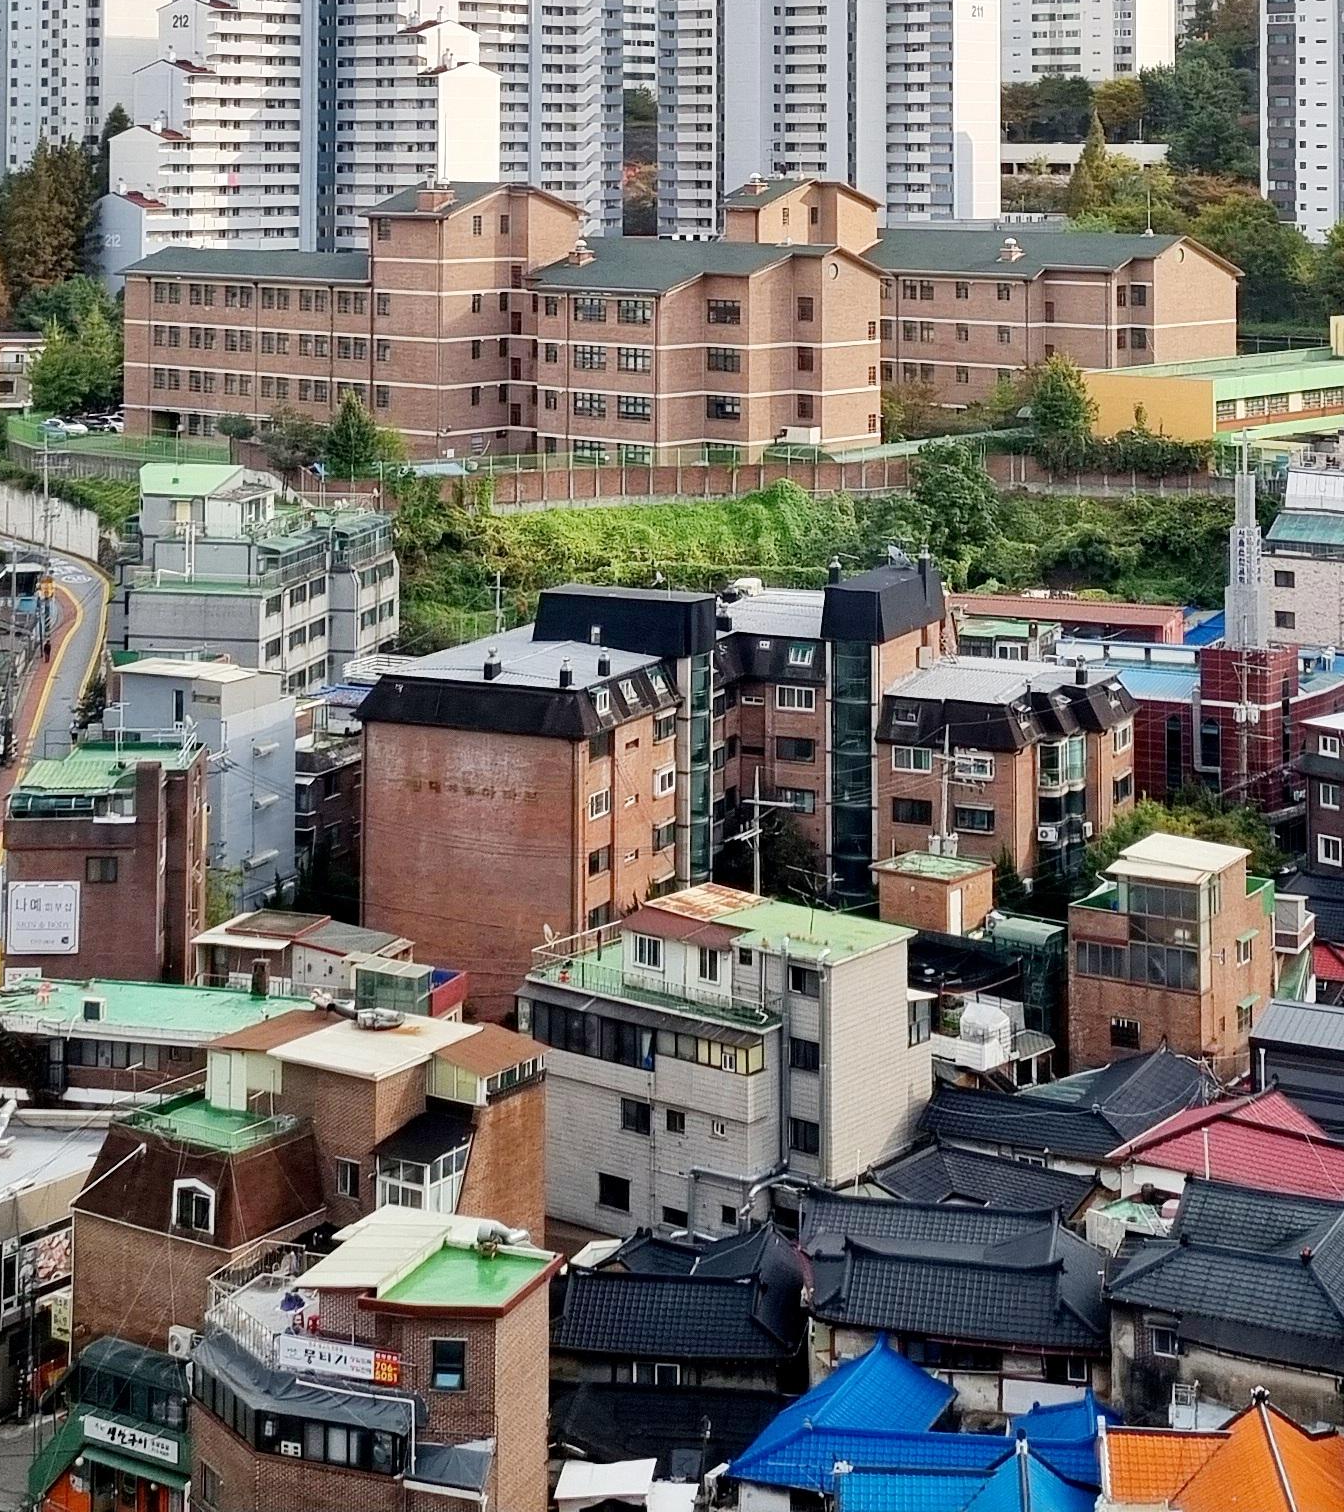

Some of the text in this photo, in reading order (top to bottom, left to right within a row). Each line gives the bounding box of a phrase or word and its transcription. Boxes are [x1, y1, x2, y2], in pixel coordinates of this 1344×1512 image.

[972, 5, 984, 17] 211
[172, 14, 189, 28] 212
[105, 234, 121, 247] 212
[304, 1349, 347, 1365] 뭉티기
[376, 1371, 398, 1383] 5051
[107, 1427, 147, 1449] 생선구이
